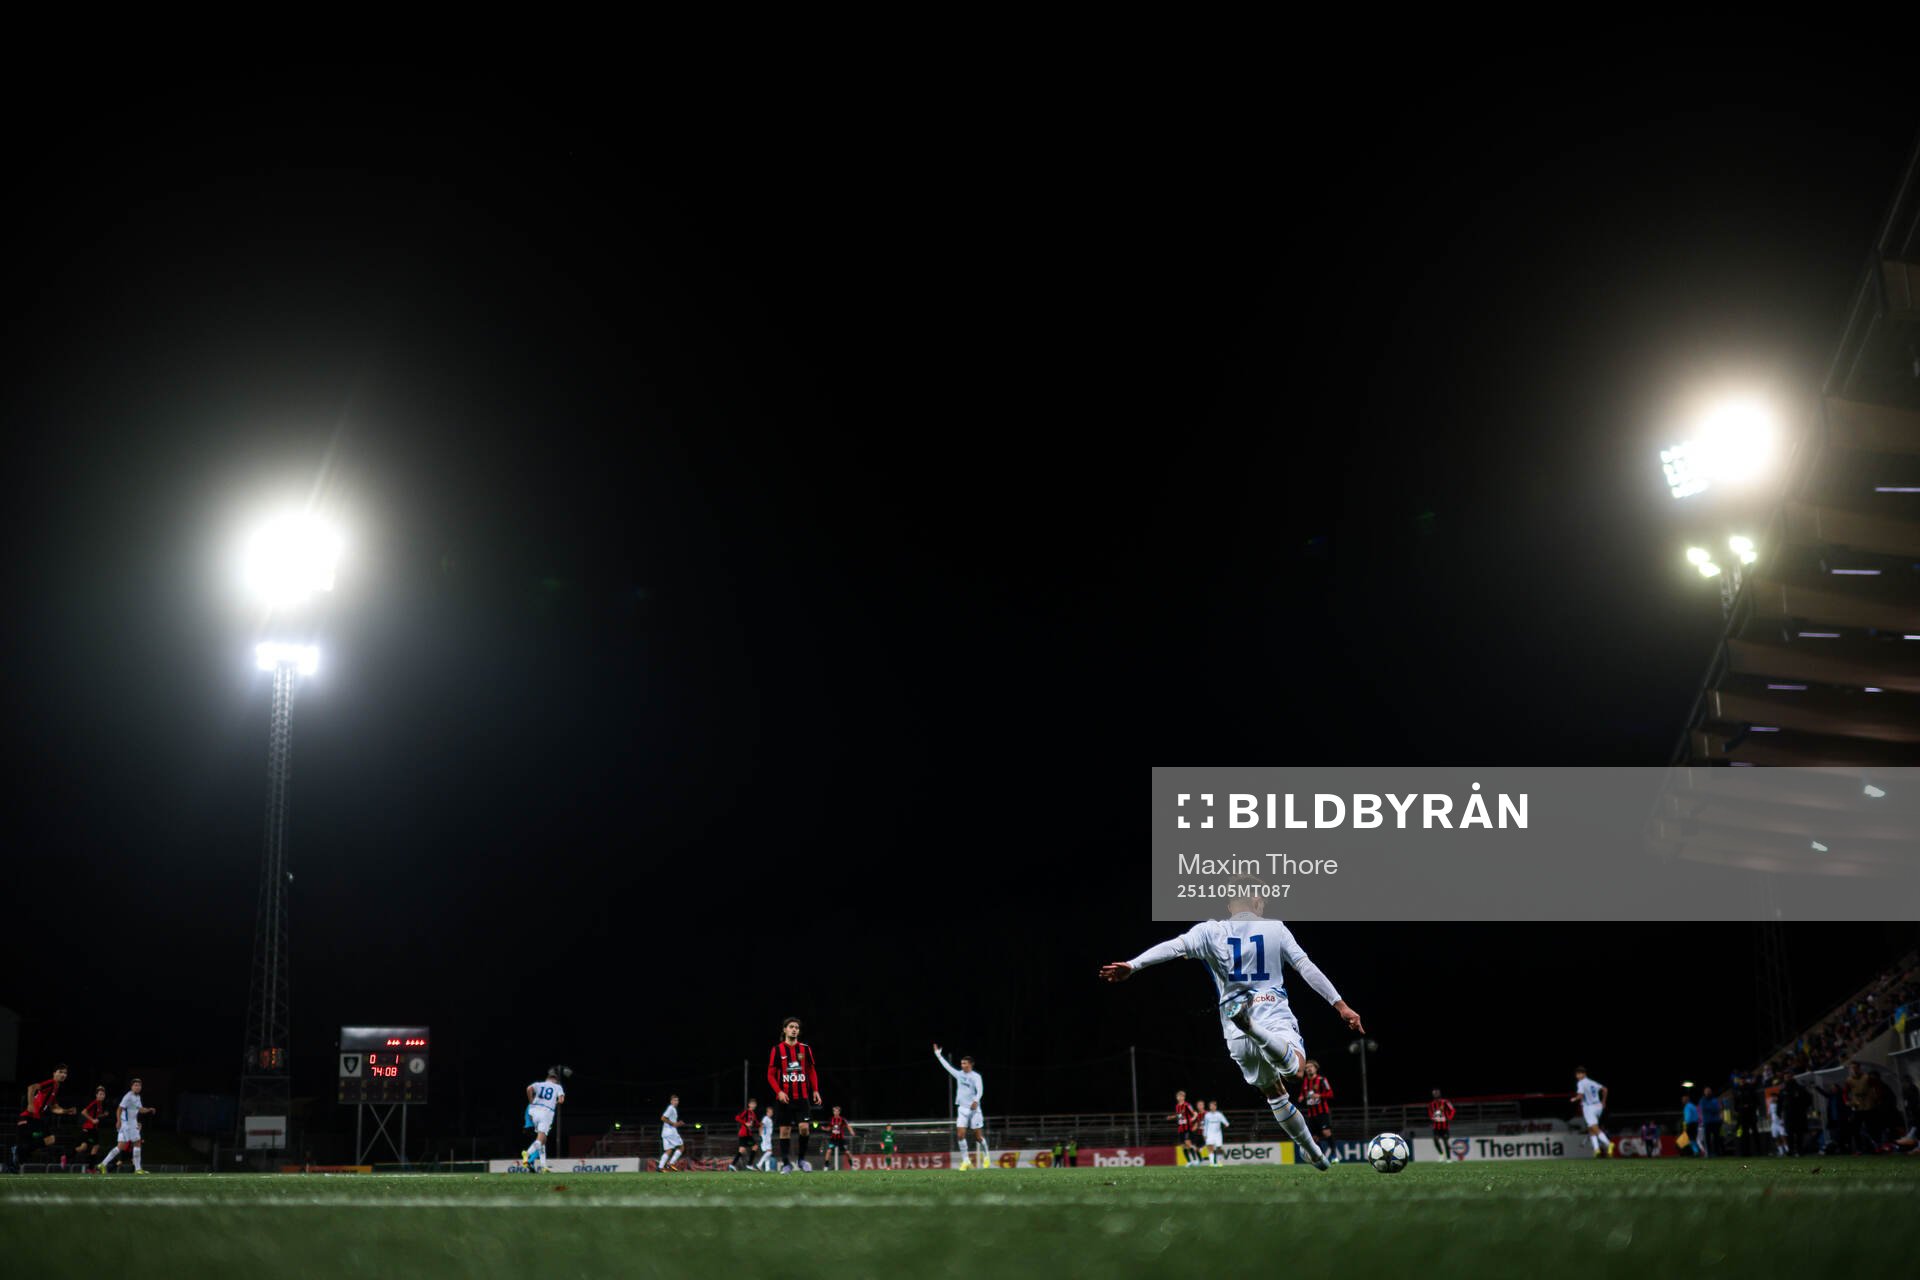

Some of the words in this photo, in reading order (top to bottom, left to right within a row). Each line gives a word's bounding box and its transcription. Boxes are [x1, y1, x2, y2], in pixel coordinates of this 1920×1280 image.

[1227, 934, 1270, 982] 11
[369, 1053, 377, 1065] 0
[370, 1066, 398, 1077] 74:08
[782, 1072, 806, 1083] NÖJD
[537, 1086, 554, 1101] 18
[1476, 1137, 1564, 1158] Thermia
[852, 1155, 943, 1170] BAUHAUS
[1093, 1150, 1145, 1167] habo
[573, 1164, 619, 1173] GIGANT
